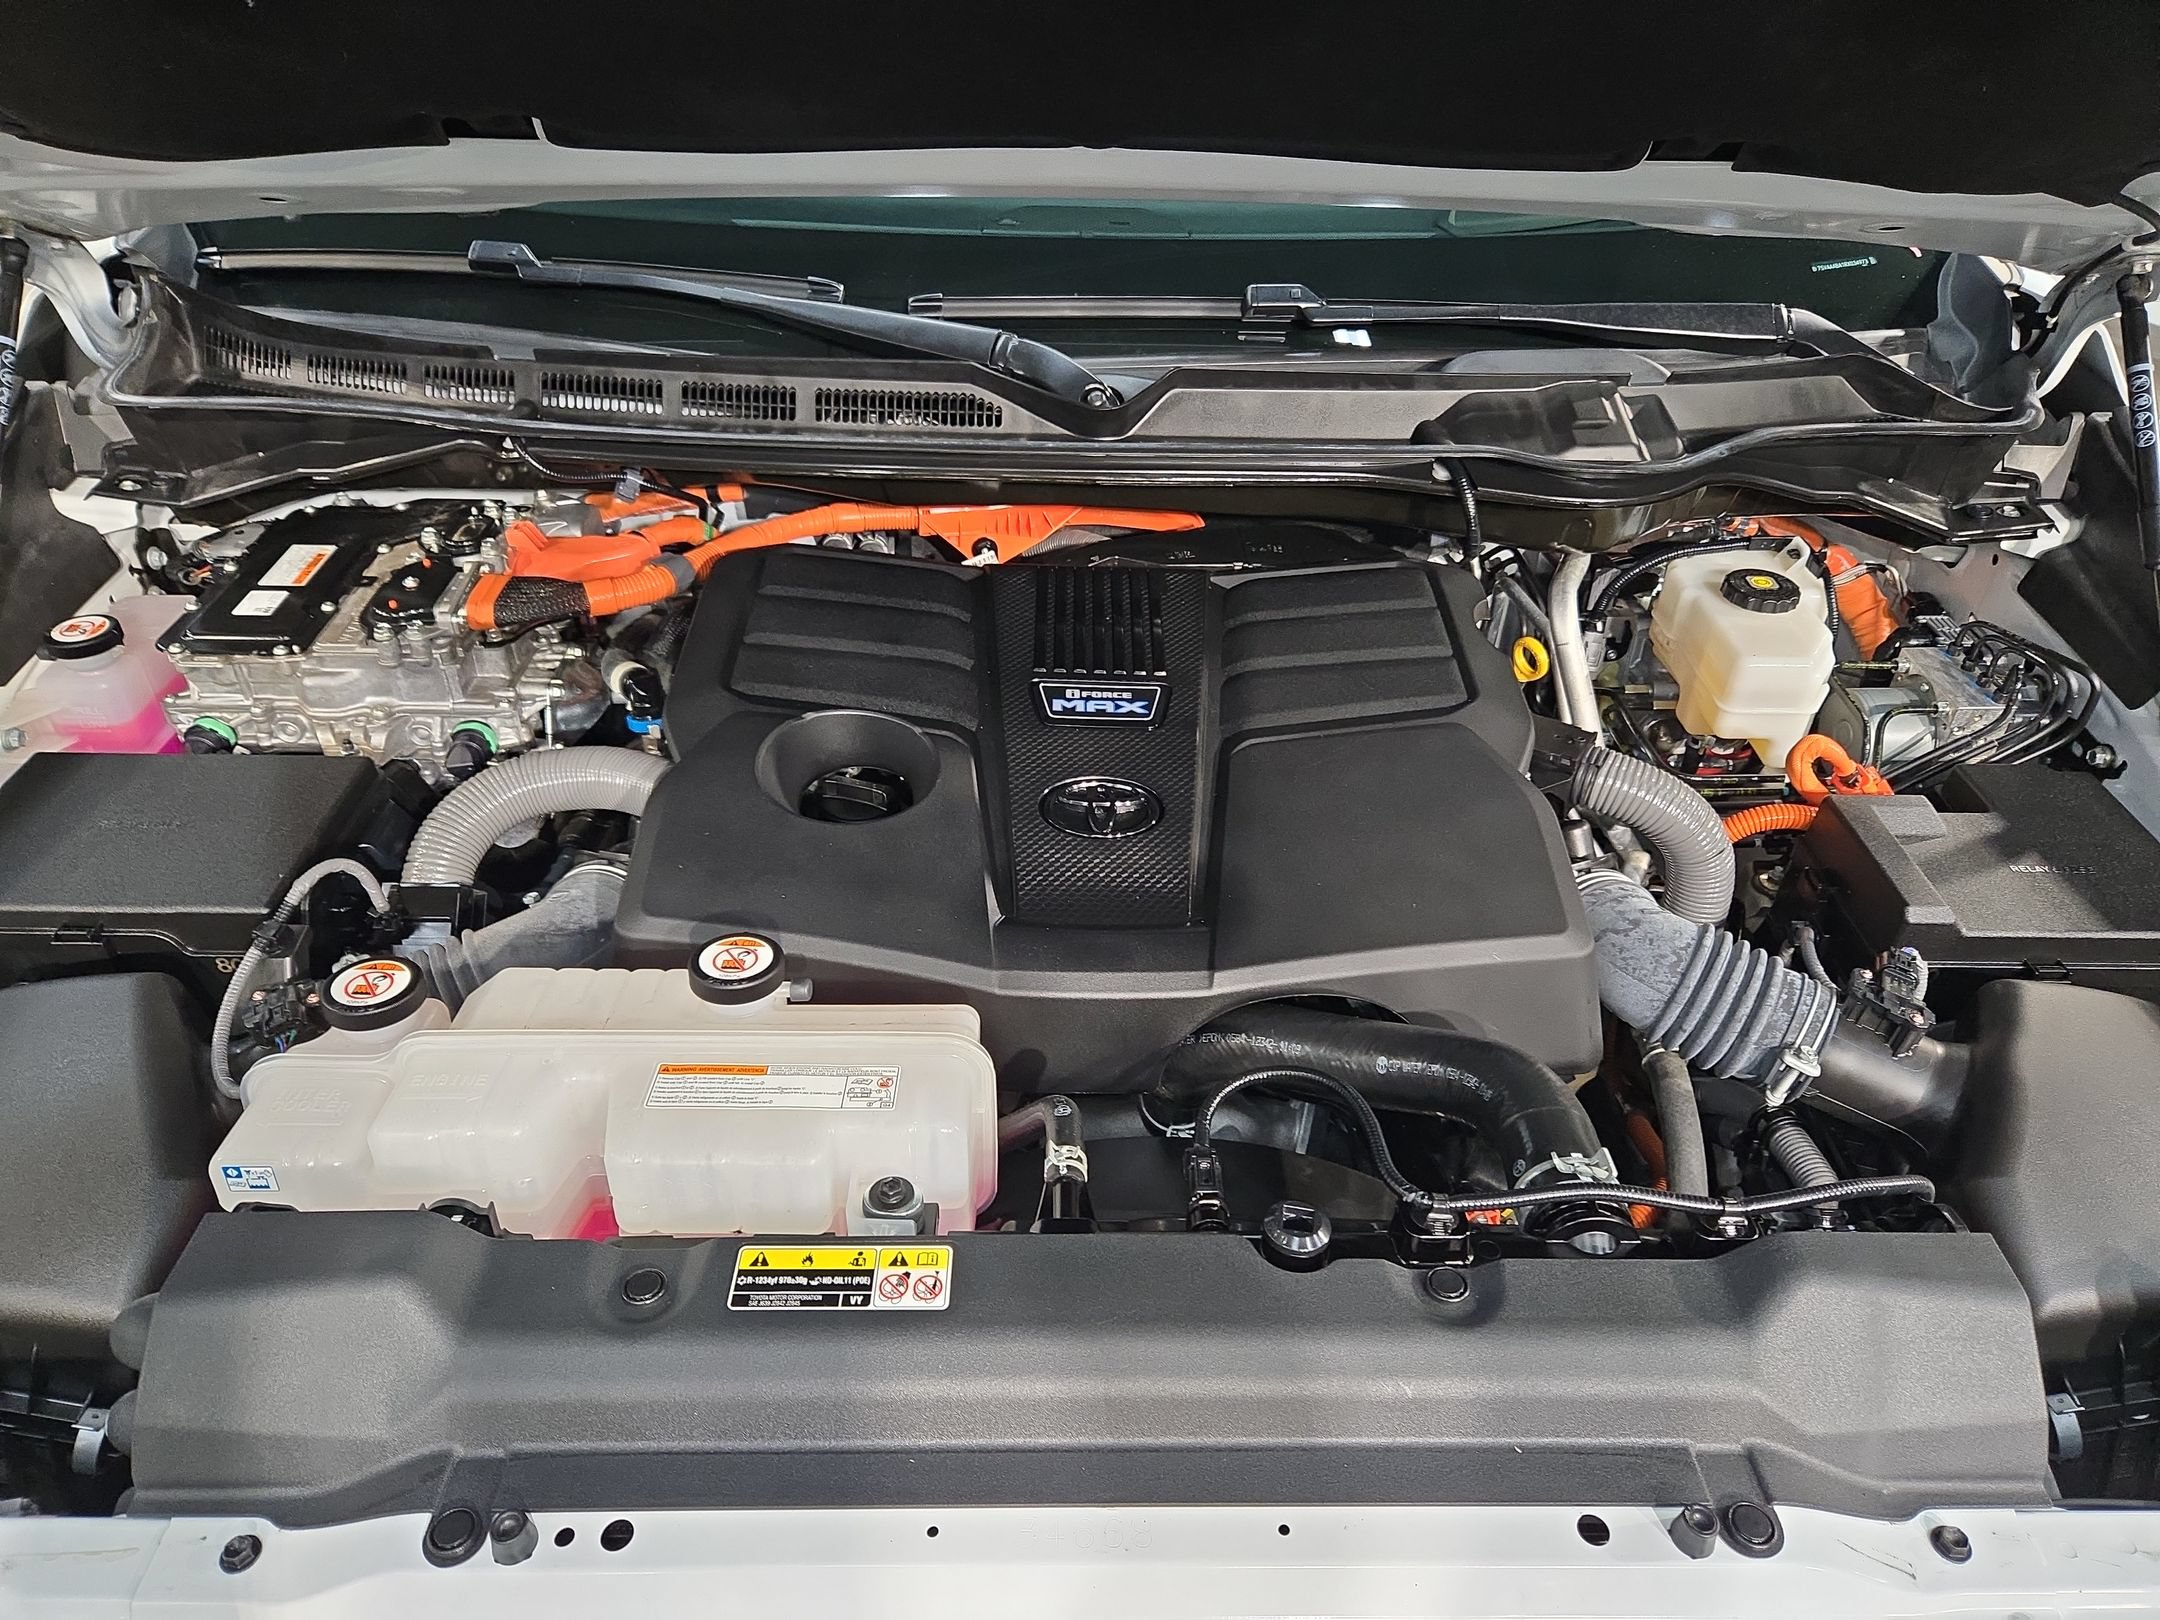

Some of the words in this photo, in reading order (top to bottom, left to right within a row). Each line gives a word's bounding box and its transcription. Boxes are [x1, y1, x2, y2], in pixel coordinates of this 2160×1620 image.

[1052, 699, 1150, 714] MAX
[2009, 865, 2050, 873] RELAY
[407, 1073, 489, 1087] ENGINE
[850, 1295, 864, 1305] VY
